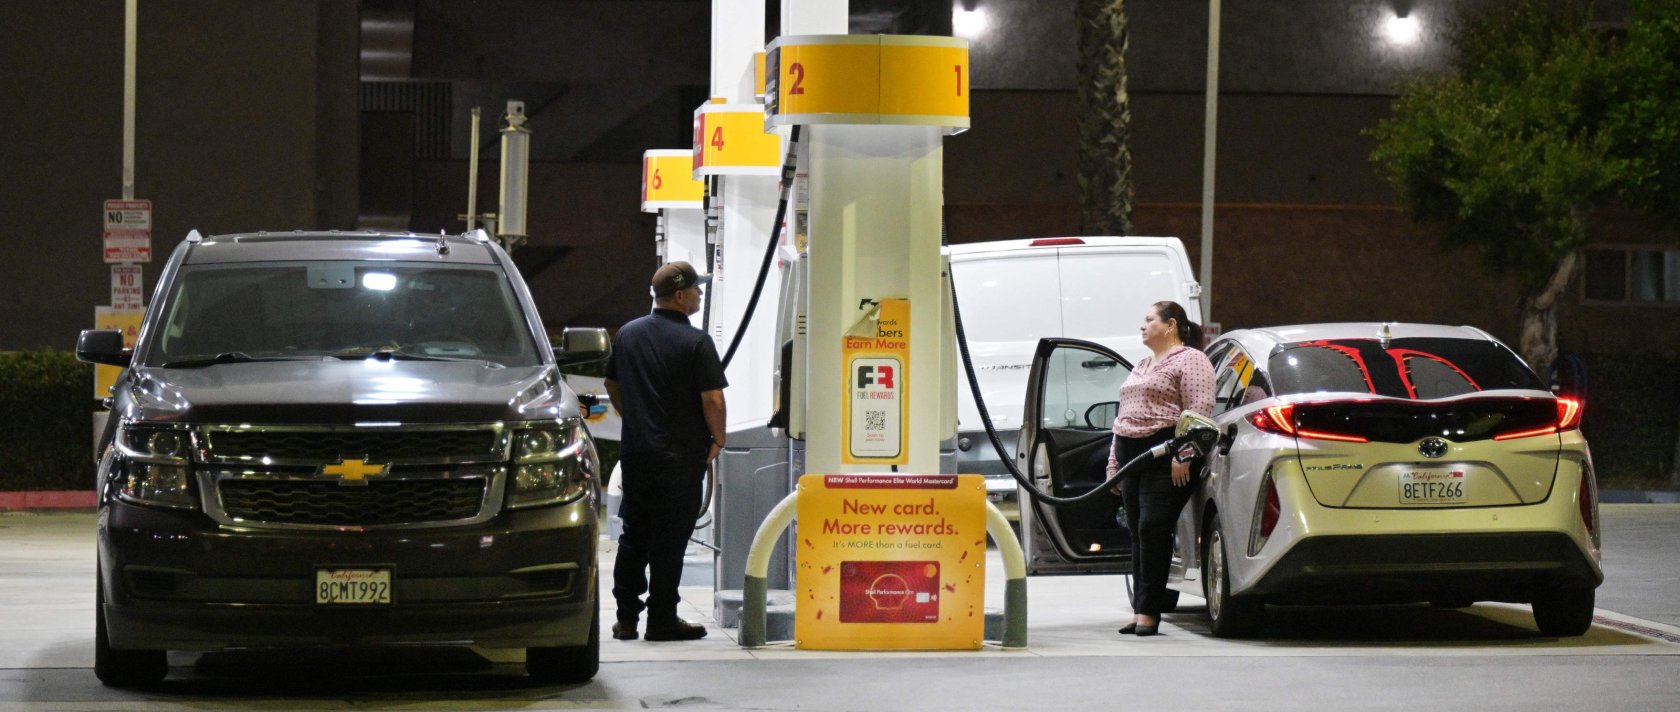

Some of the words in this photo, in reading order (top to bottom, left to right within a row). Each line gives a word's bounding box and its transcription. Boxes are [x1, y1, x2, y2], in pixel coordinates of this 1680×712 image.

[789, 62, 805, 95] 2
[954, 65, 962, 97] 1
[711, 126, 725, 151] 4
[652, 168, 662, 190] 6
[108, 211, 123, 224] NO
[119, 274, 134, 286] NO
[113, 287, 141, 295] PARKING
[877, 327, 903, 338] bers
[846, 339, 872, 349] Earn
[876, 339, 906, 349] More
[857, 391, 869, 400] FUEL
[1404, 482, 1463, 499] 8ETF266
[843, 499, 887, 515] New
[893, 498, 940, 515] card.
[822, 518, 871, 535] More
[878, 518, 959, 535] rewards.
[832, 540, 845, 549] It's
[848, 541, 874, 549] MORE
[876, 540, 894, 549] than
[905, 540, 920, 549] fuel
[922, 540, 943, 549] card.
[320, 582, 388, 600] 8CMT992
